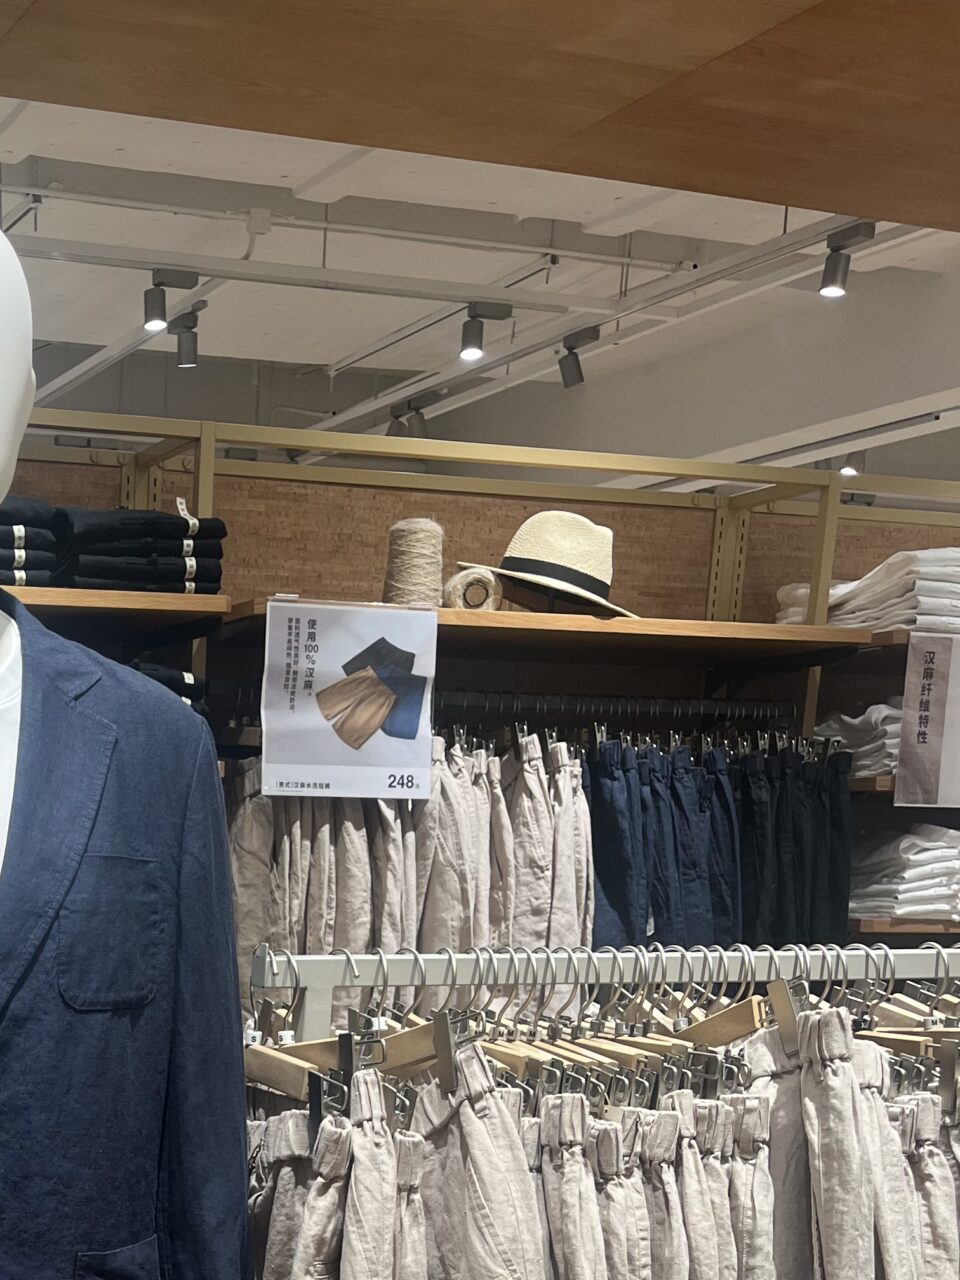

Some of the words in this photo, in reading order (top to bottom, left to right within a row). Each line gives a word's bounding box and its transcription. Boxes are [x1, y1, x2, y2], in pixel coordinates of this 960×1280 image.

[916, 651, 936, 744] 汉麻纤维特性
